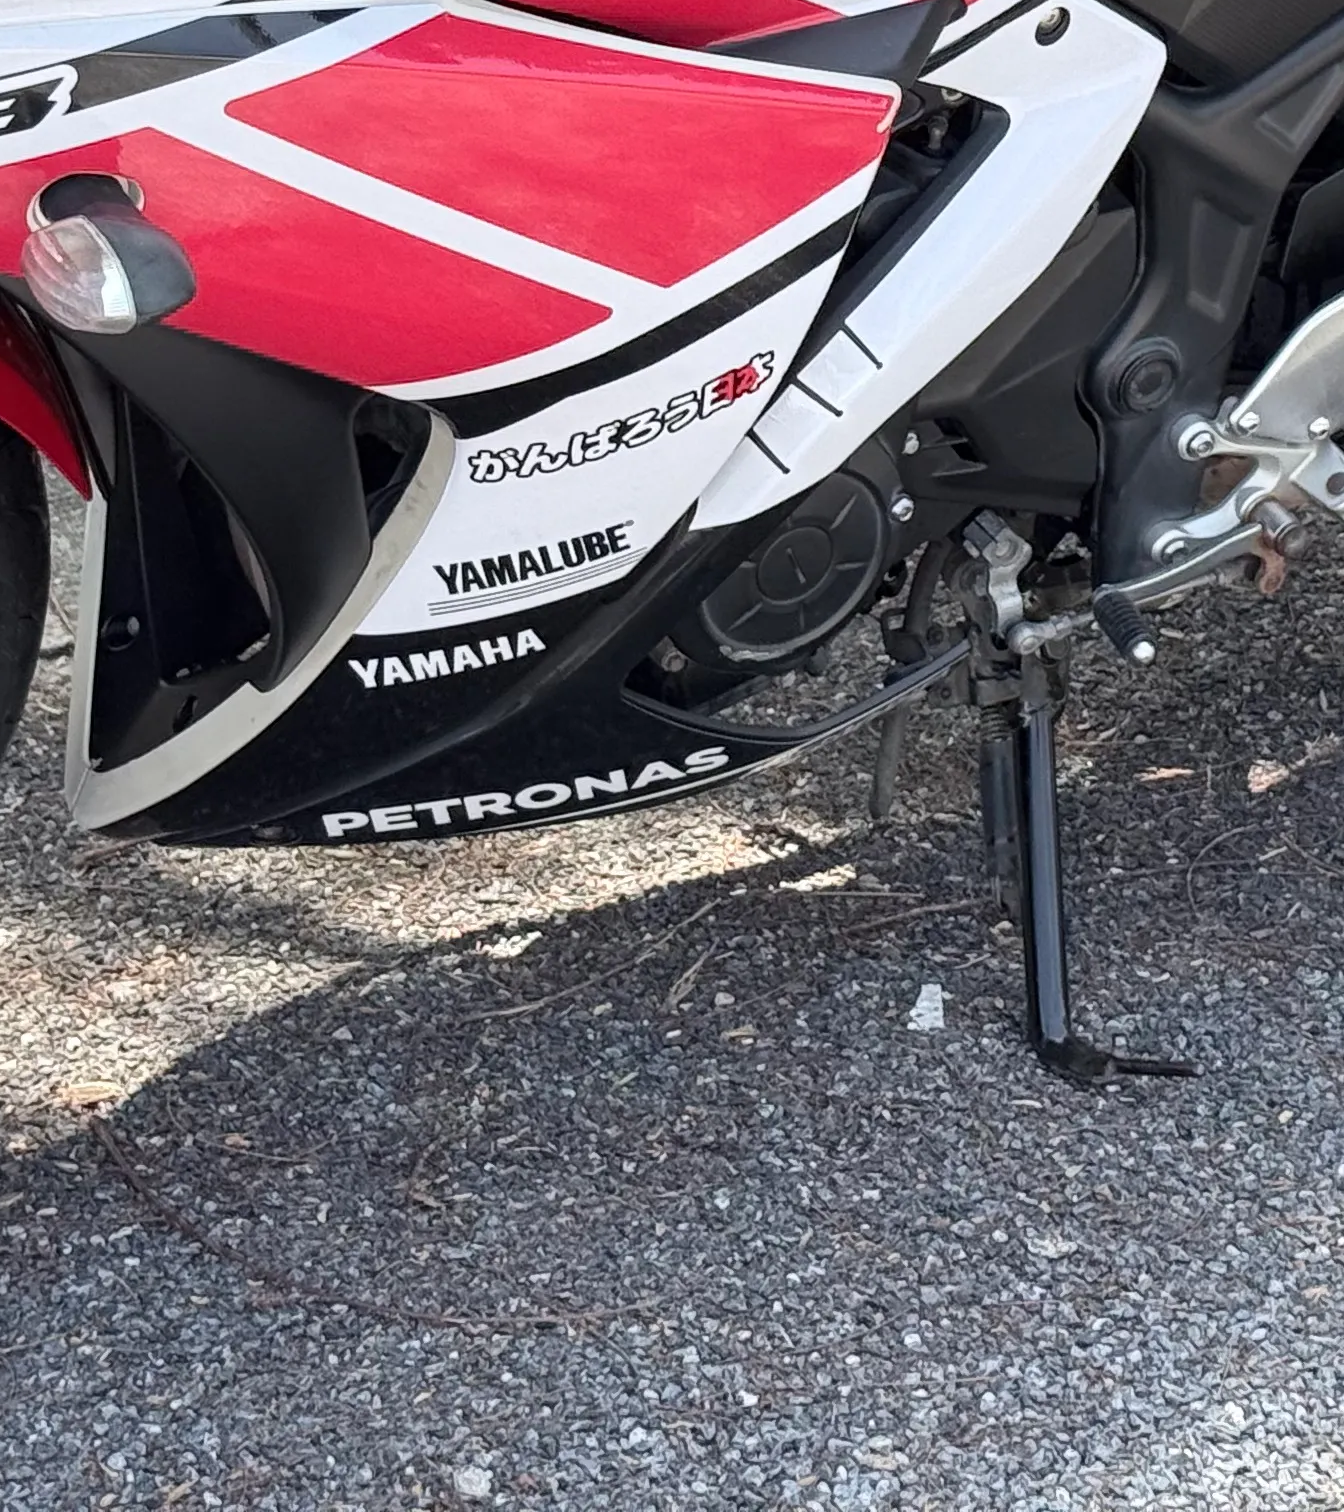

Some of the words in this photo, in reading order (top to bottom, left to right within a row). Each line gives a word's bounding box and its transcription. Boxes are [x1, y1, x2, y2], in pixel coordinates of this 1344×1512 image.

[468, 350, 775, 483] がんばろう日本
[434, 522, 633, 596] YAMALUBE
[347, 628, 546, 689] YAMAHA
[322, 746, 731, 838] PETRONAS
